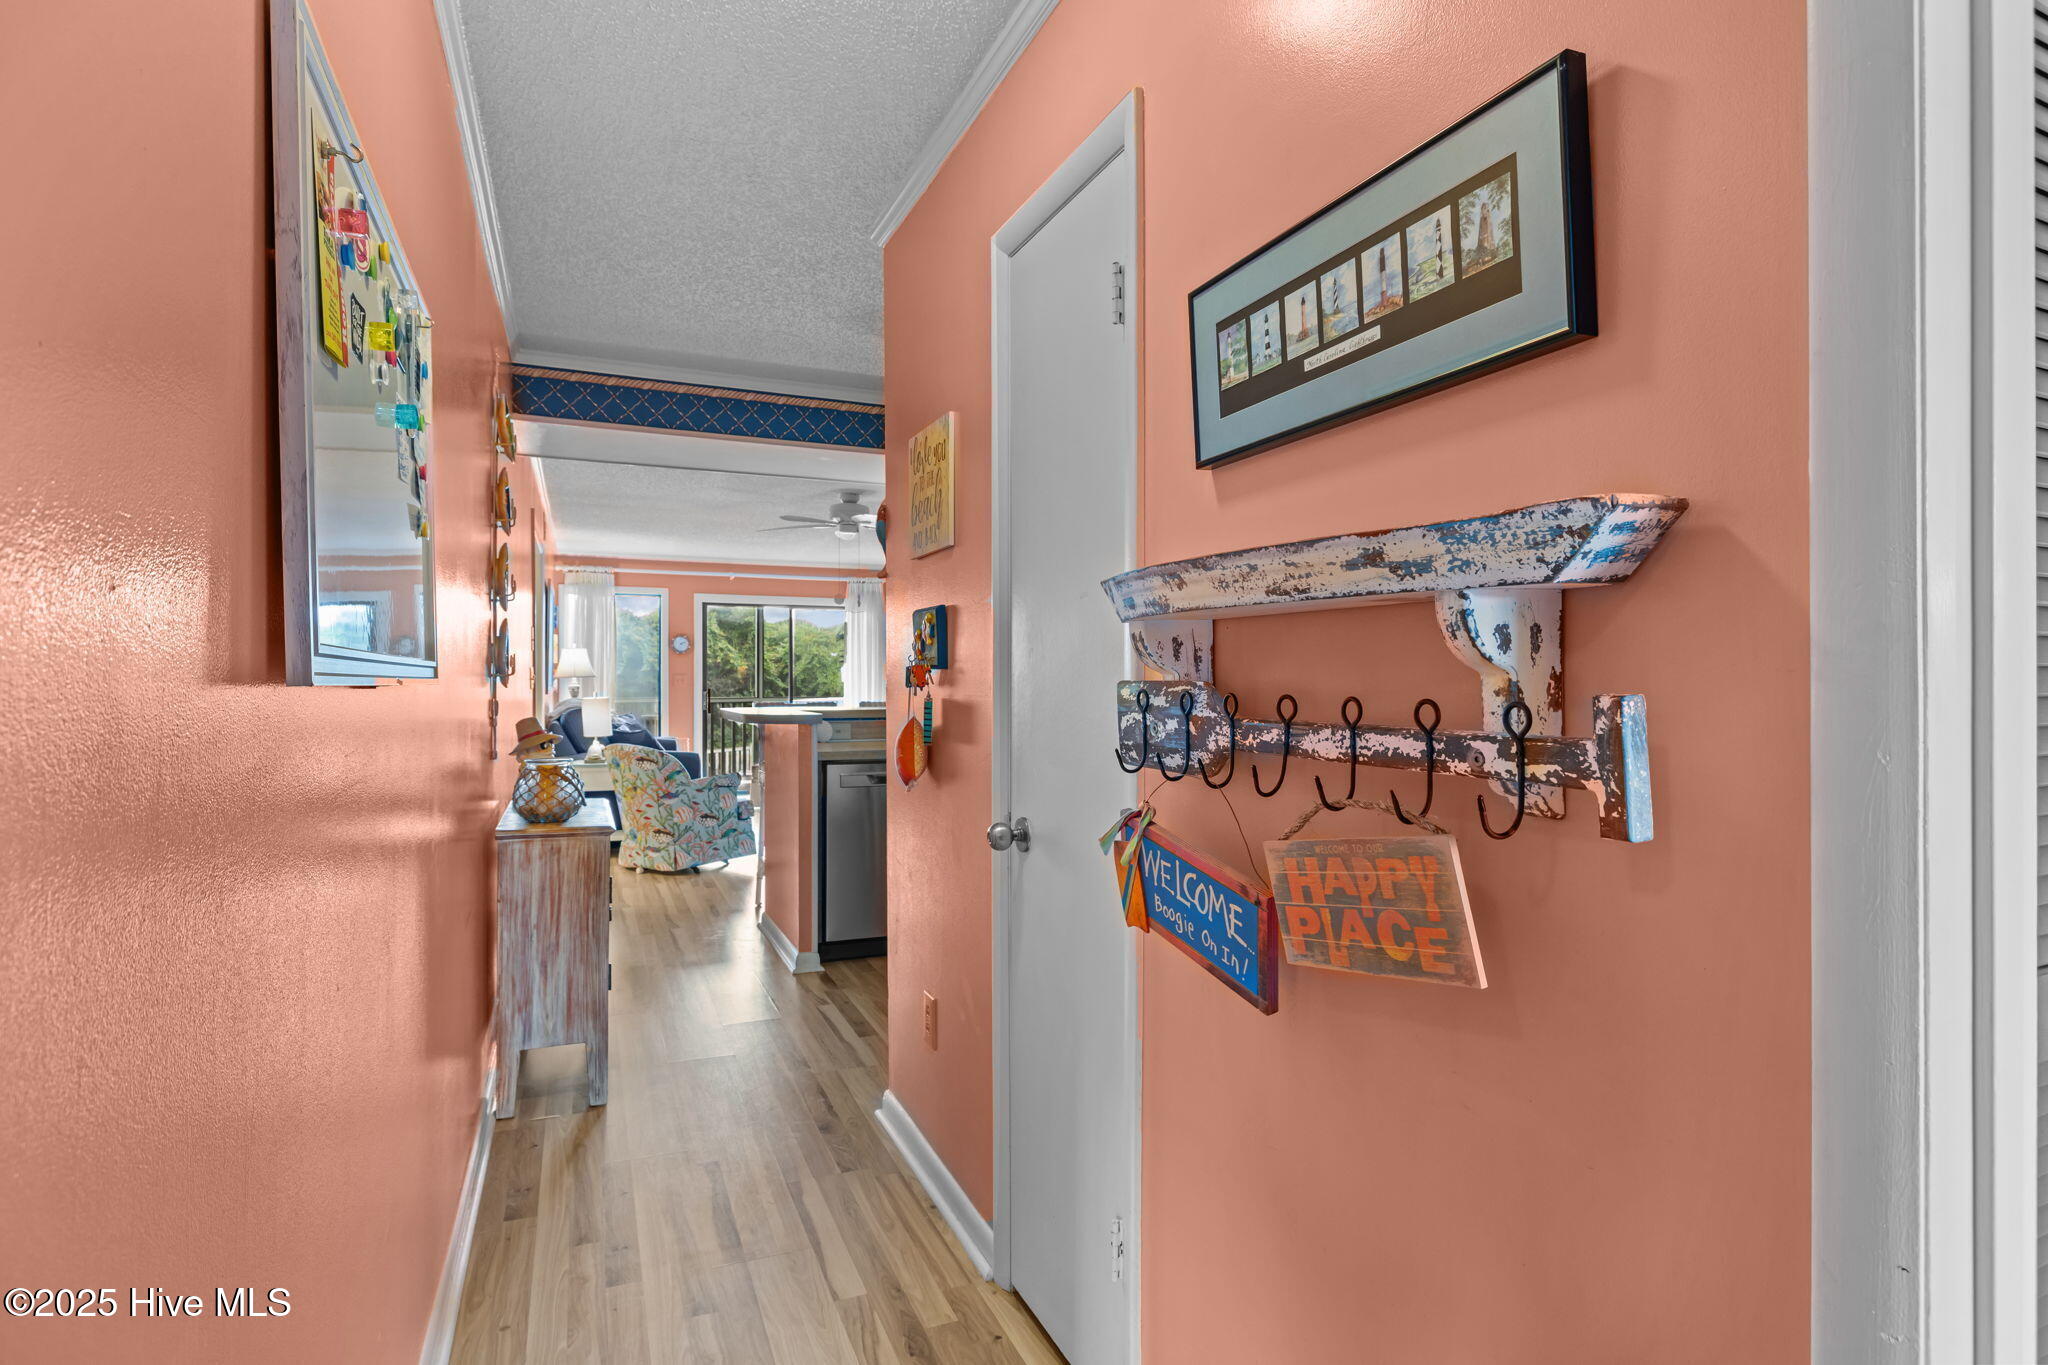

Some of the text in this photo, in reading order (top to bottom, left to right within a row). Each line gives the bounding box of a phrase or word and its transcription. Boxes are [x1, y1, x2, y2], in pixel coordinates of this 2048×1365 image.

[1315, 843, 1384, 855] WELCOME TO OUR
[1283, 855, 1441, 922] HAPPY
[1153, 892, 1250, 982] Boogie On In!
[1285, 905, 1456, 975] PLACE
